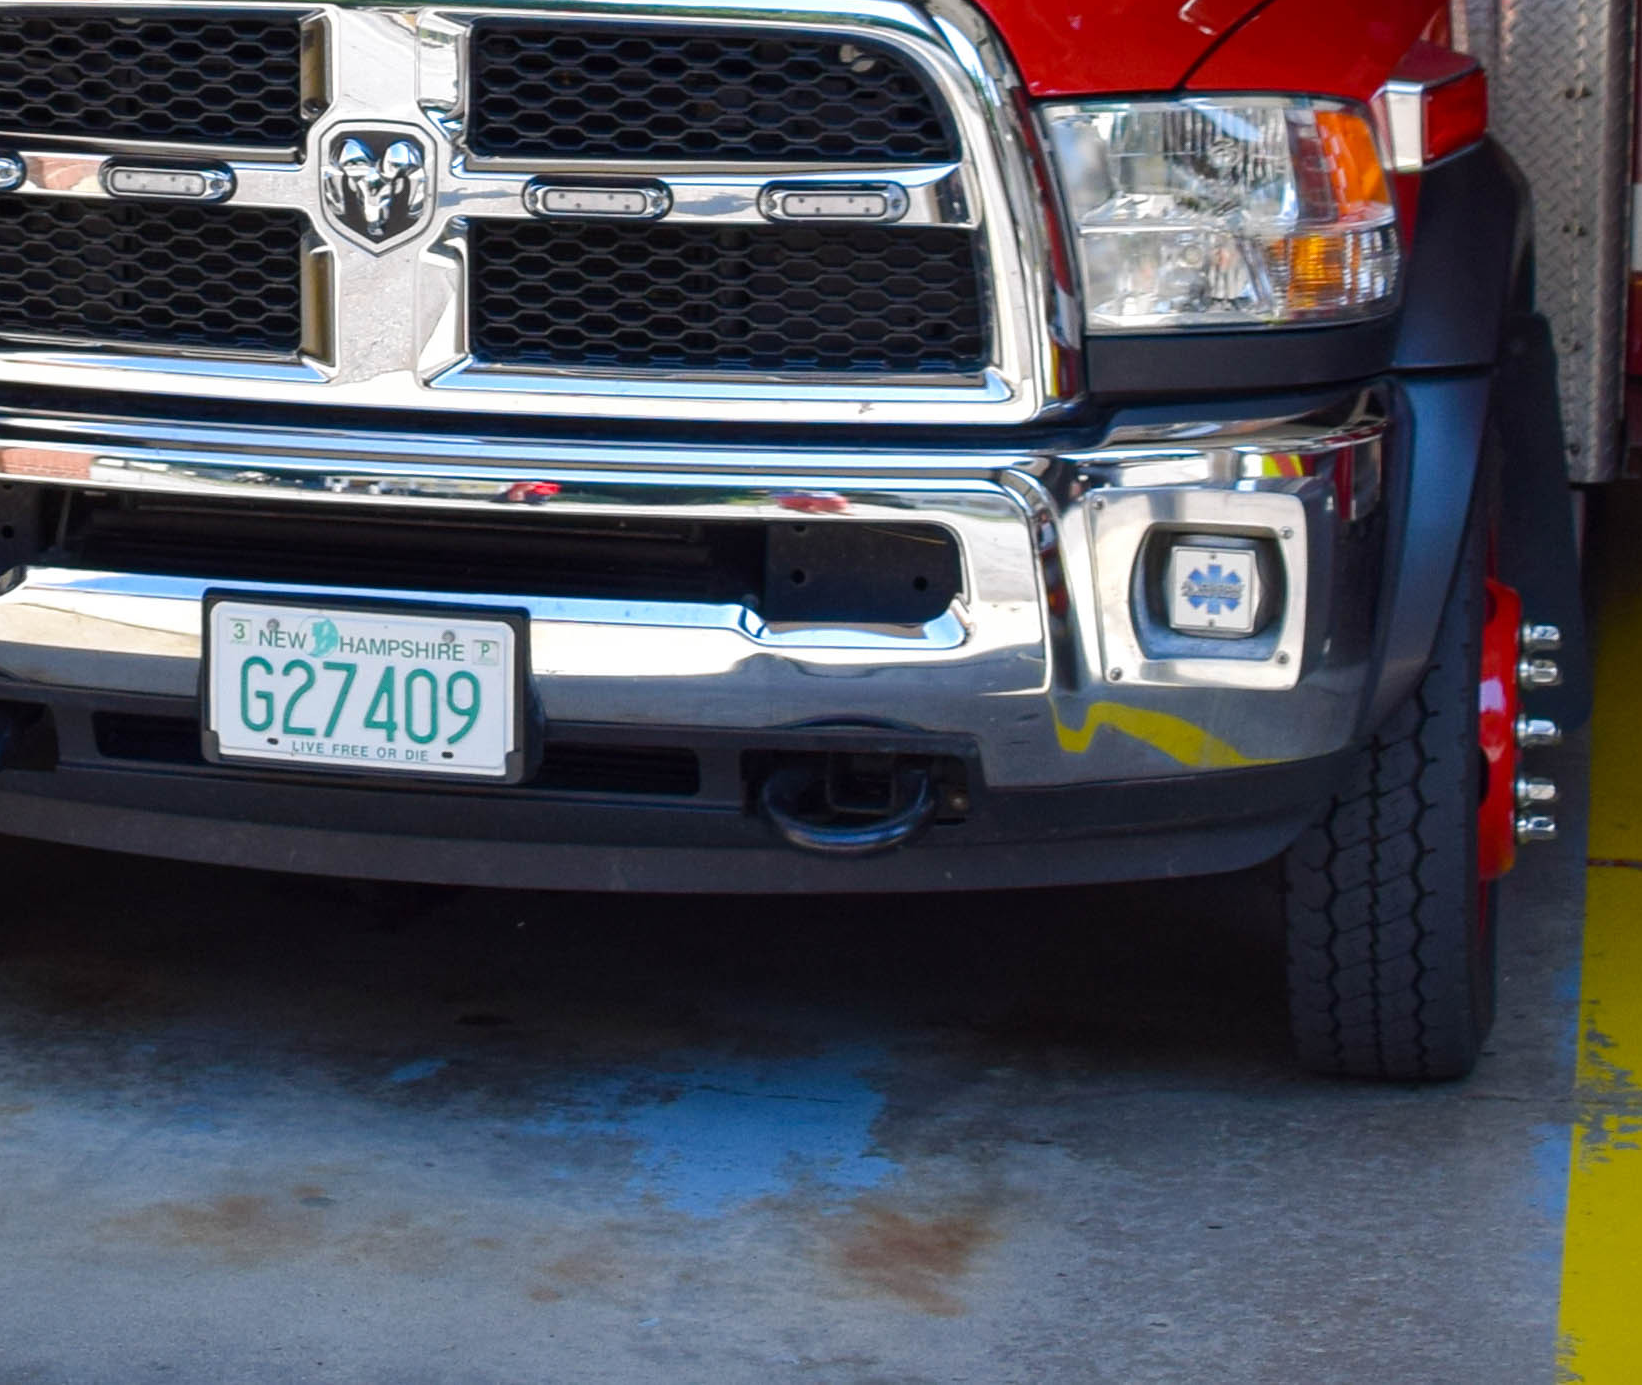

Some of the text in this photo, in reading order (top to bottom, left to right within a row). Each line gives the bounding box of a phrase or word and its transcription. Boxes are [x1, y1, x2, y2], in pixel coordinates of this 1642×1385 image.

[233, 622, 246, 640] 3
[258, 628, 465, 662] NEW HAMPSHIRE
[240, 655, 481, 745] G27409
[292, 740, 429, 762] LIVE FREE OR DIE
